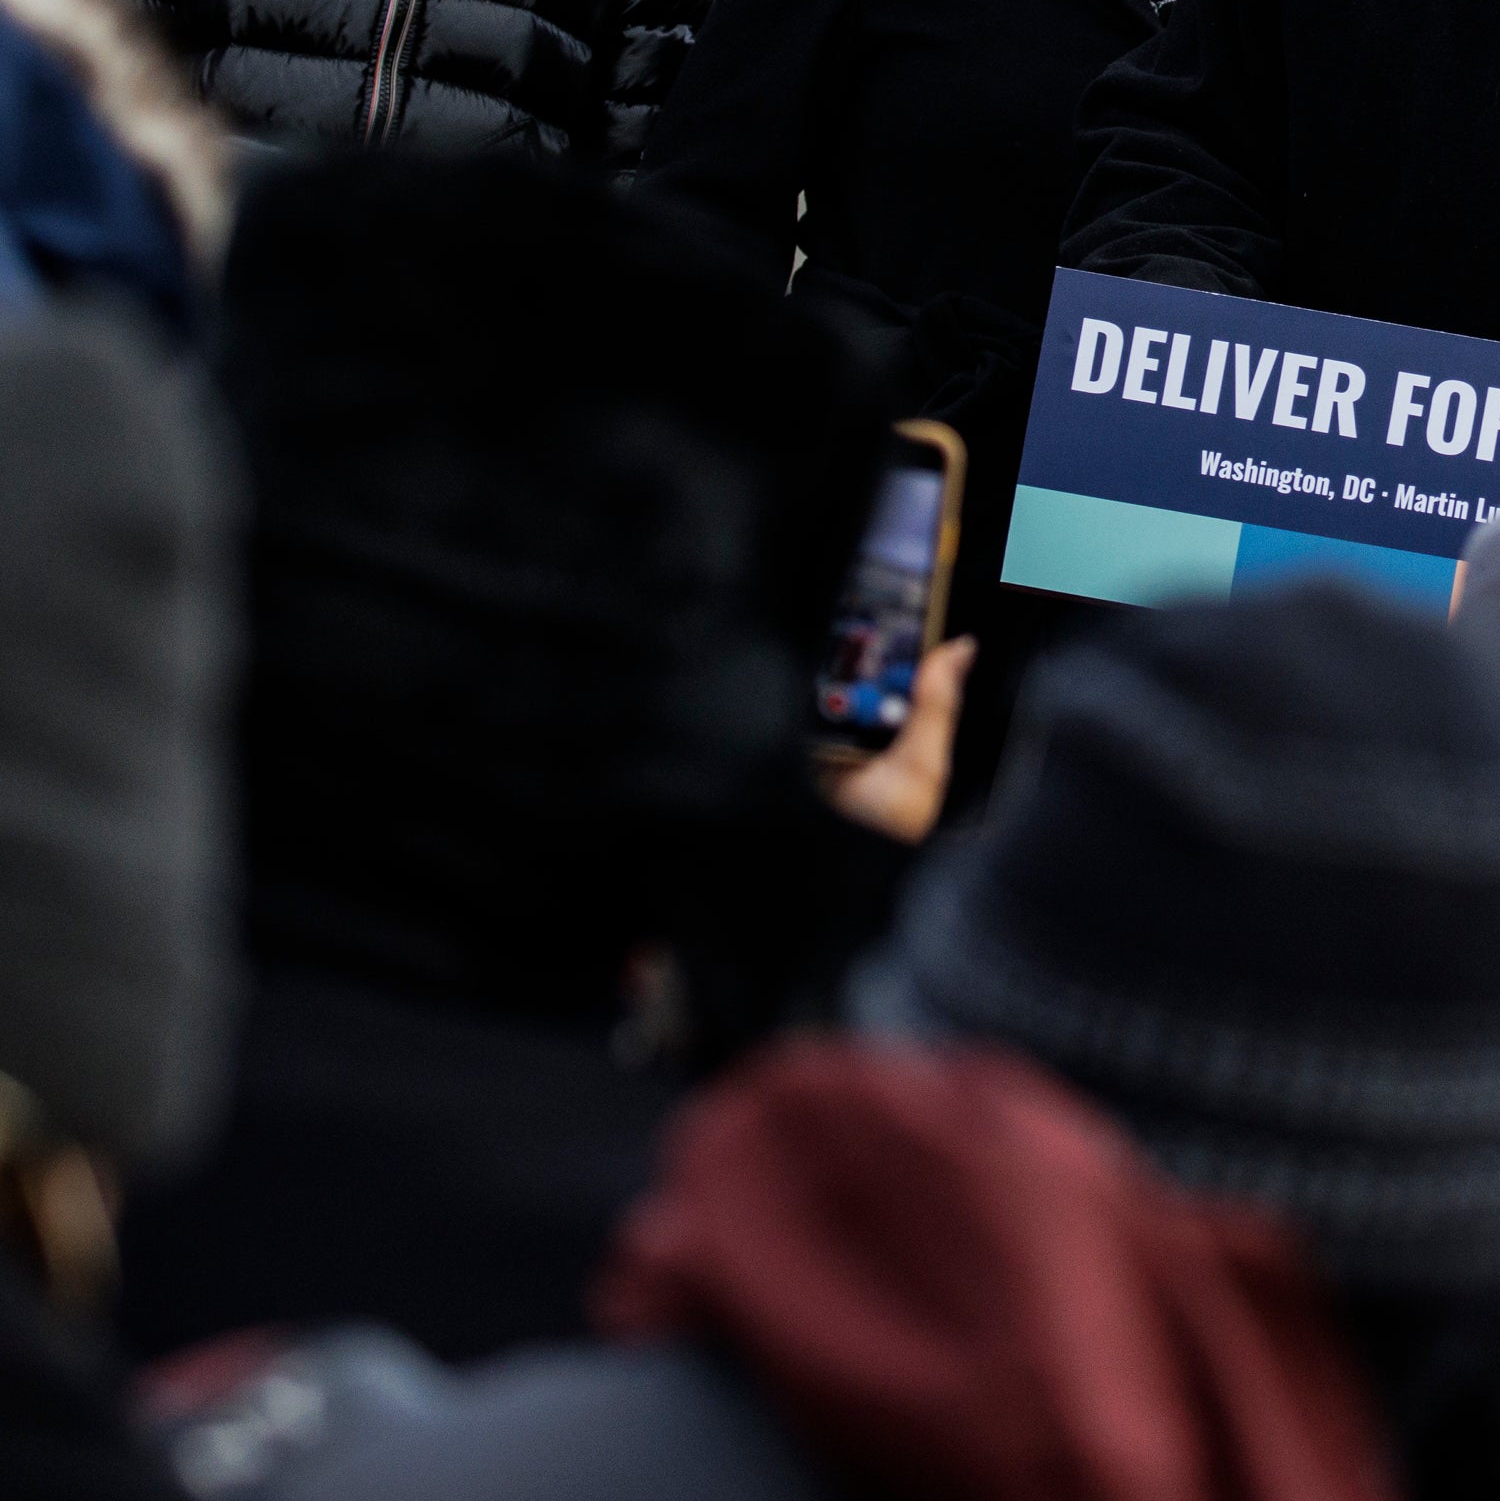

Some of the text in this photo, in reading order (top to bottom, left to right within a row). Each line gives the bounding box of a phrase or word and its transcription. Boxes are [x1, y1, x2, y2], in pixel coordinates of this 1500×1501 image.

[1070, 317, 1367, 439] DELIVER
[1200, 449, 1335, 501] Washington,
[1342, 474, 1377, 504] DC
[1393, 483, 1469, 520] Martin
